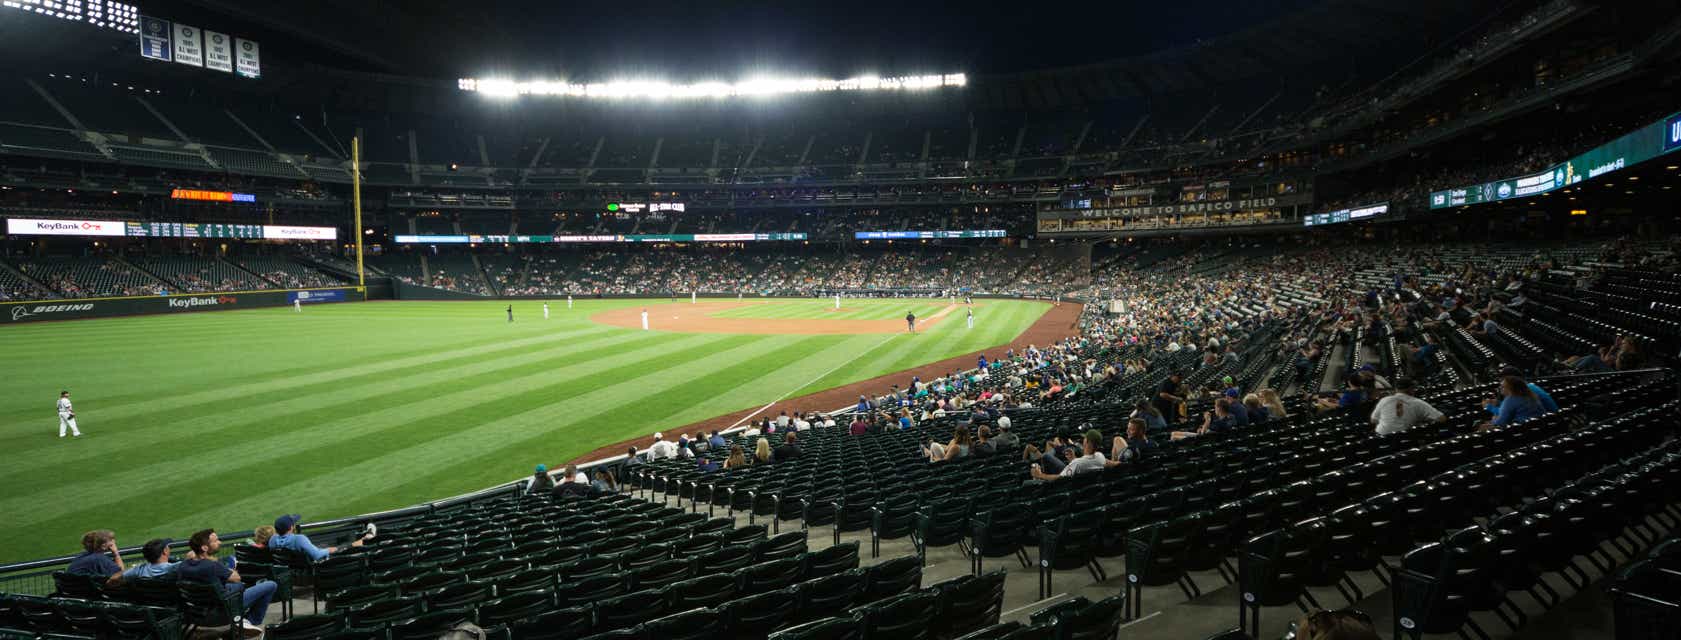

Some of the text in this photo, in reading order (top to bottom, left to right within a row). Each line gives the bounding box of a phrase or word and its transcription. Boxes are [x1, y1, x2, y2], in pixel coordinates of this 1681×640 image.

[176, 53, 202, 63] CHAMPIONS
[207, 60, 231, 69] CHAMPIONS
[1081, 198, 1276, 218] WELCOME TO SAFECO FIELD
[37, 222, 79, 231] KeyBank
[169, 296, 218, 308] KeyBank
[33, 303, 94, 313] BOEING
